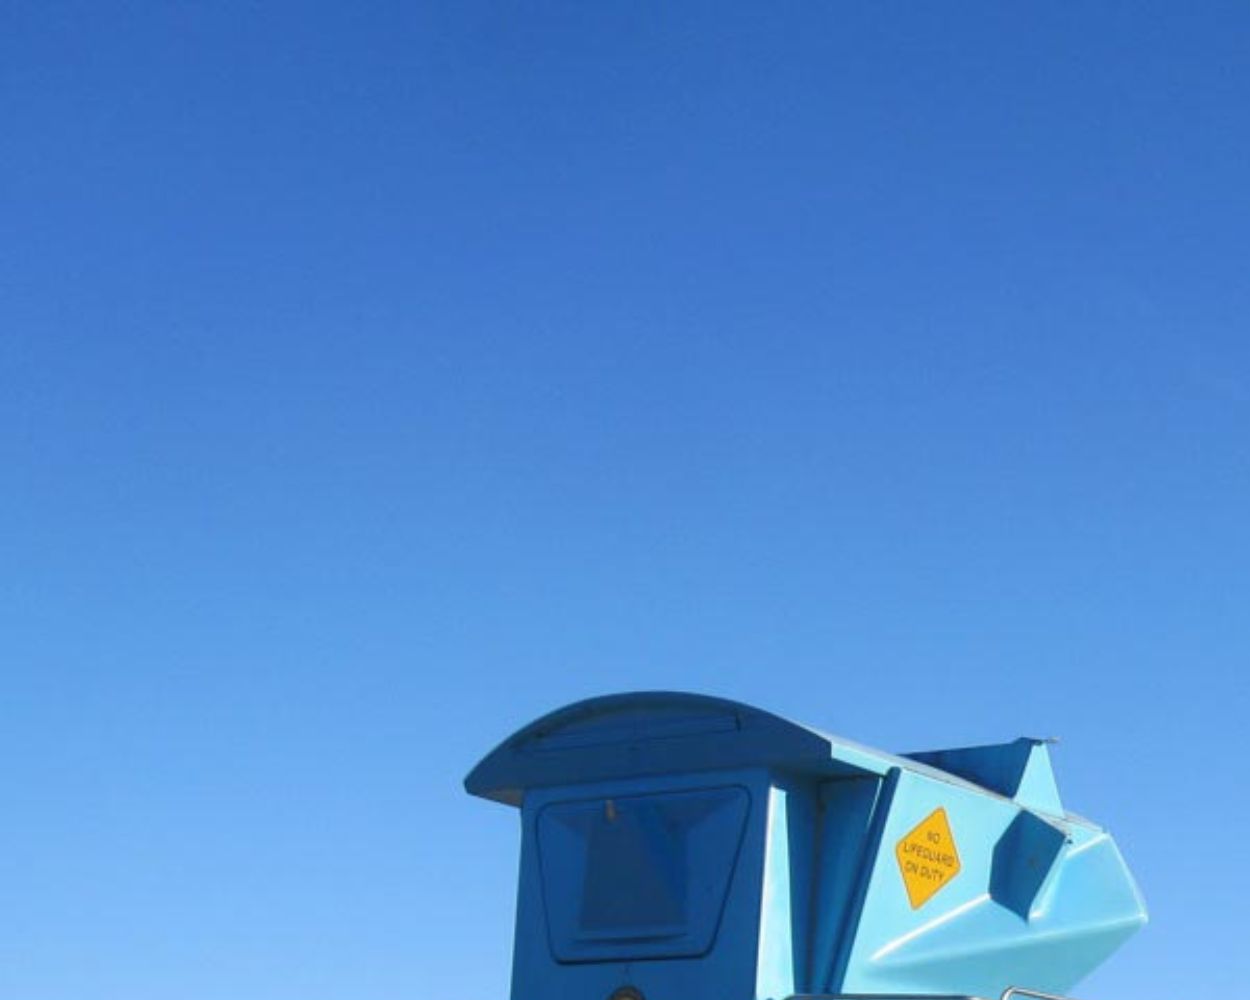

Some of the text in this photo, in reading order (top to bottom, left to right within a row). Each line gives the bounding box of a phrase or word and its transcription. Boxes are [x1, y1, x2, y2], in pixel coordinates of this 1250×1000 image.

[927, 832, 941, 844] NO
[904, 842, 955, 868] LIFEGUARD
[904, 861, 919, 874] ON
